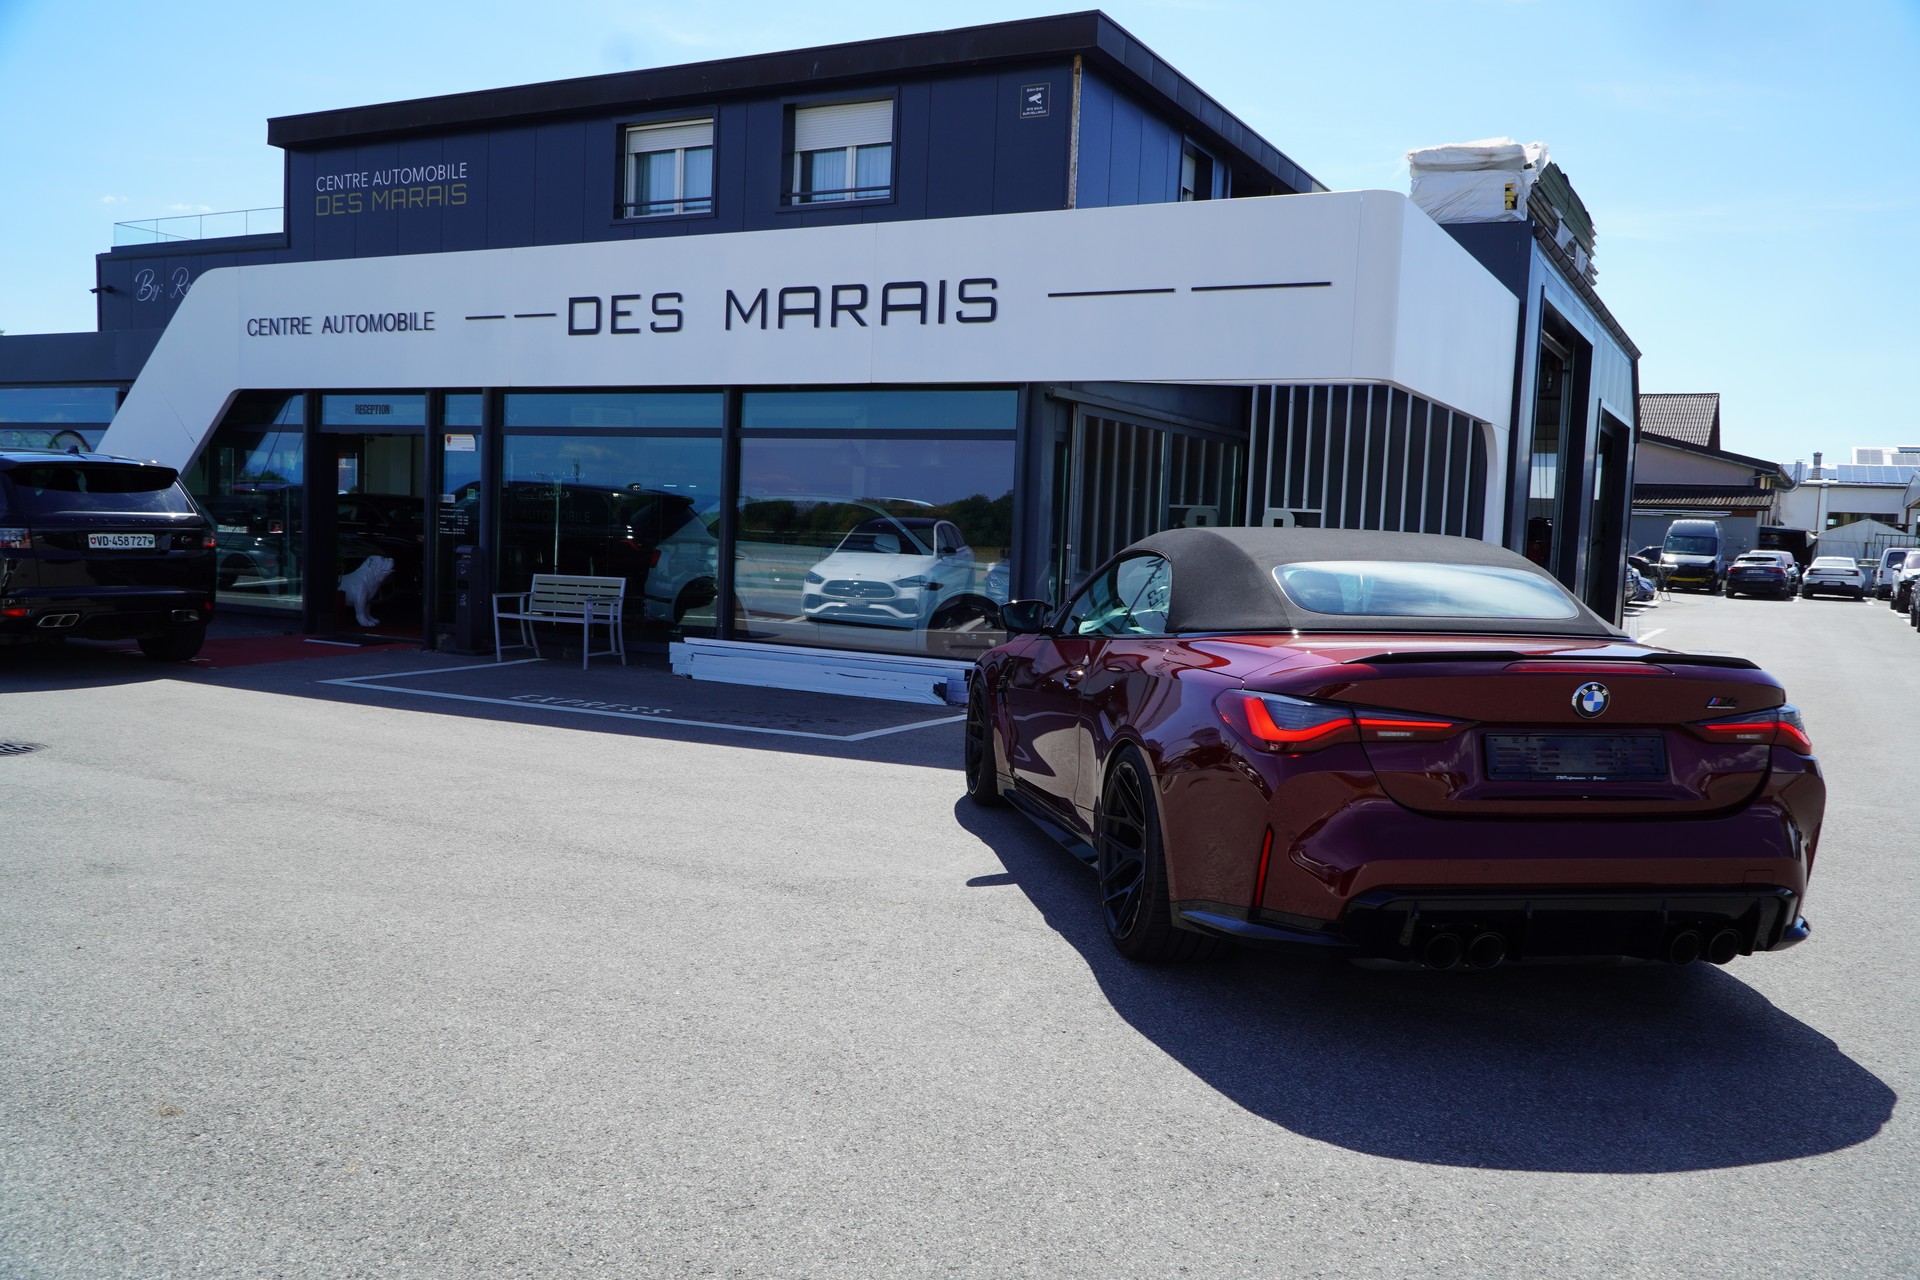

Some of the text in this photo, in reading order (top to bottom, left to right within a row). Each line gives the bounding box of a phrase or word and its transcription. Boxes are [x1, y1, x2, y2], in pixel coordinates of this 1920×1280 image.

[316, 162, 468, 192] CENTRE AUTOMOBILE
[316, 184, 467, 216] DES MARAIS
[567, 278, 998, 336] DES MARAIS
[246, 311, 436, 337] CENTRE AUTOMOBILE
[354, 404, 391, 415] RECEPTION
[508, 693, 673, 715] EXPRESS
